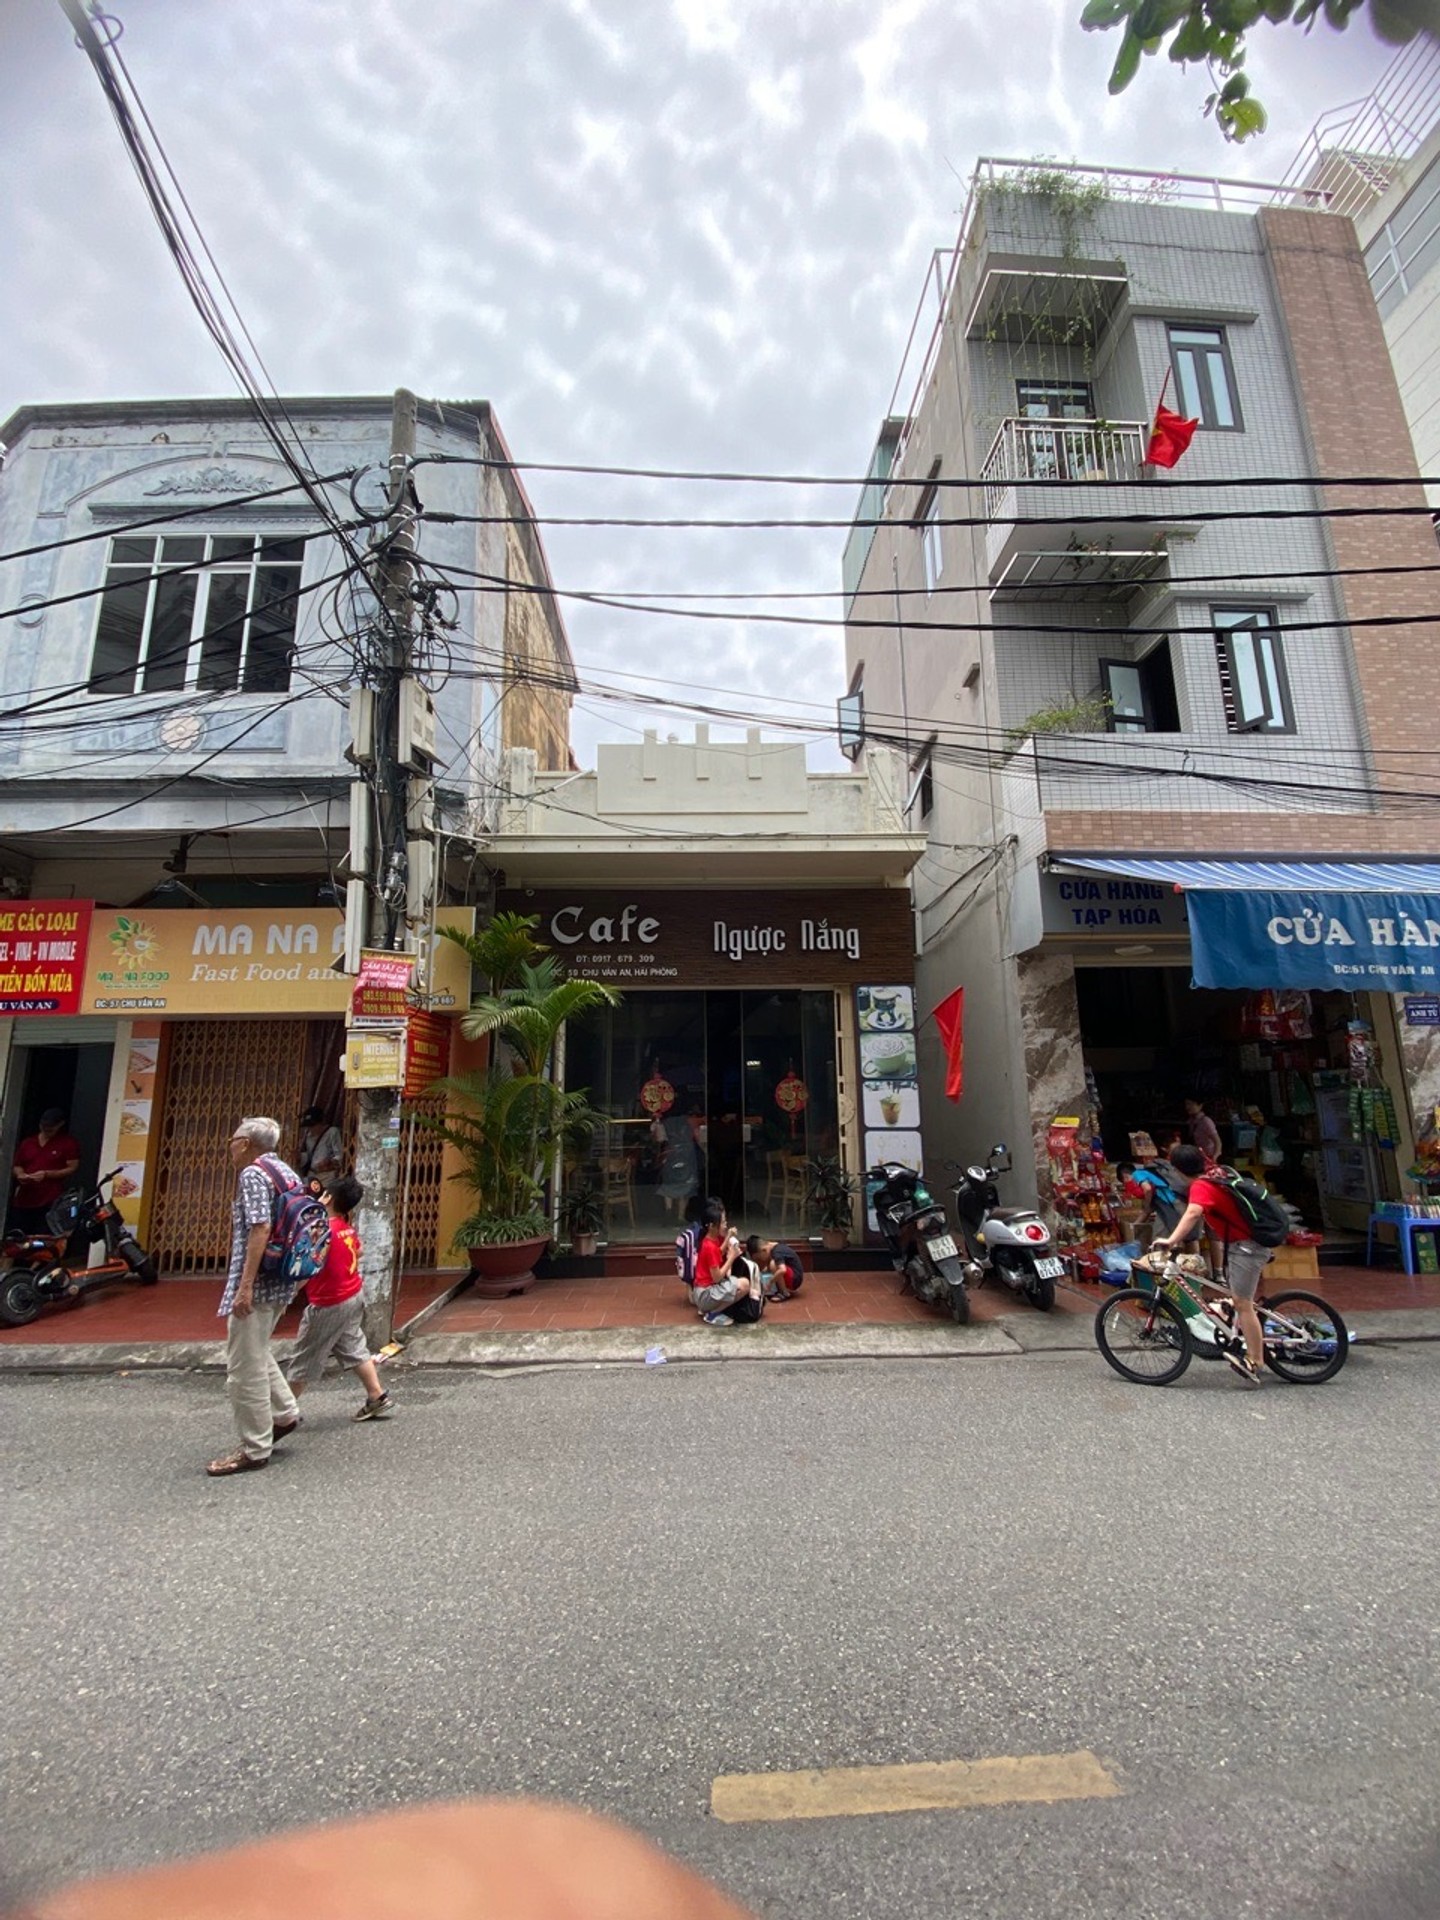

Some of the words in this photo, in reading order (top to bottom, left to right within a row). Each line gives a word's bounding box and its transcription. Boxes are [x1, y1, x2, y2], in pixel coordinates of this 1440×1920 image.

[18, 907, 44, 931] CÁC
[46, 912, 79, 936] LOẠI
[551, 904, 660, 944] Cafe
[1072, 908, 1111, 928] TẠP
[1268, 908, 1356, 945] CỬA
[191, 924, 253, 955] MA
[266, 924, 318, 954] NA
[714, 921, 786, 960] Ngược
[801, 918, 860, 959] Nắng
[24, 965, 48, 992] BỐN
[48, 967, 73, 992] MÙA
[189, 963, 239, 981] Fast
[244, 963, 301, 982] Food
[581, 969, 599, 977] CHU
[650, 966, 678, 977] PHÒNG
[36, 1001, 53, 1011] AN
